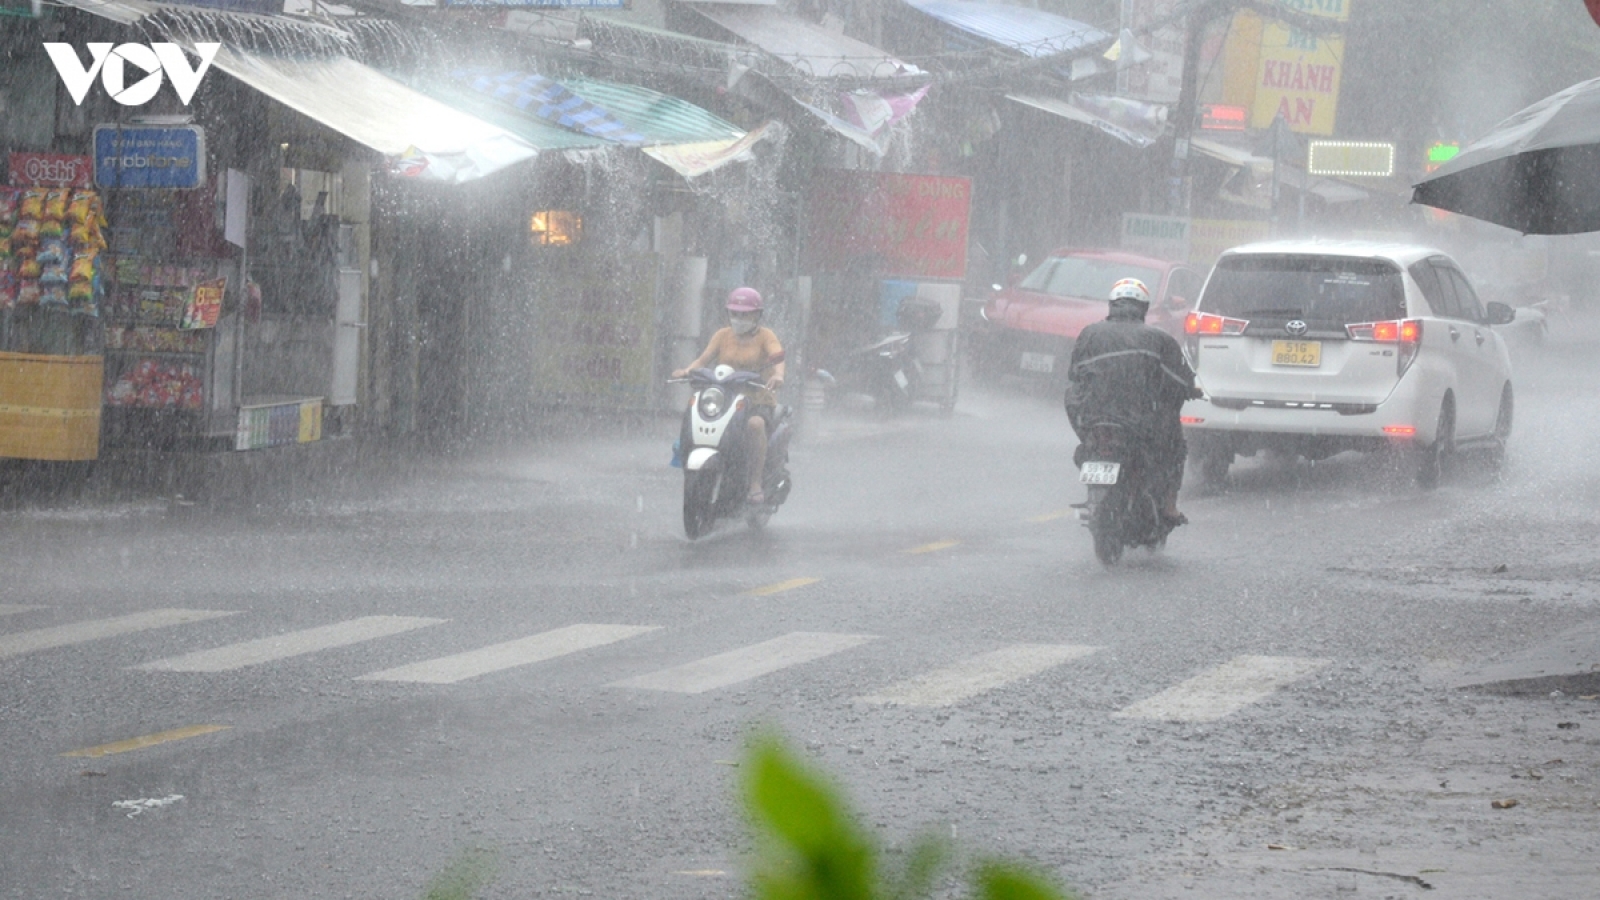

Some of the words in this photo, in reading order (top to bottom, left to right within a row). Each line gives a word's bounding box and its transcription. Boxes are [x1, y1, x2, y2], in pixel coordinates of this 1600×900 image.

[1262, 55, 1334, 93] KHÁNH
[1279, 95, 1316, 126] AN
[25, 158, 75, 182] Oishi
[103, 152, 190, 168] mobifone
[1285, 342, 1307, 353] 51G
[1275, 352, 1315, 365] 880.42
